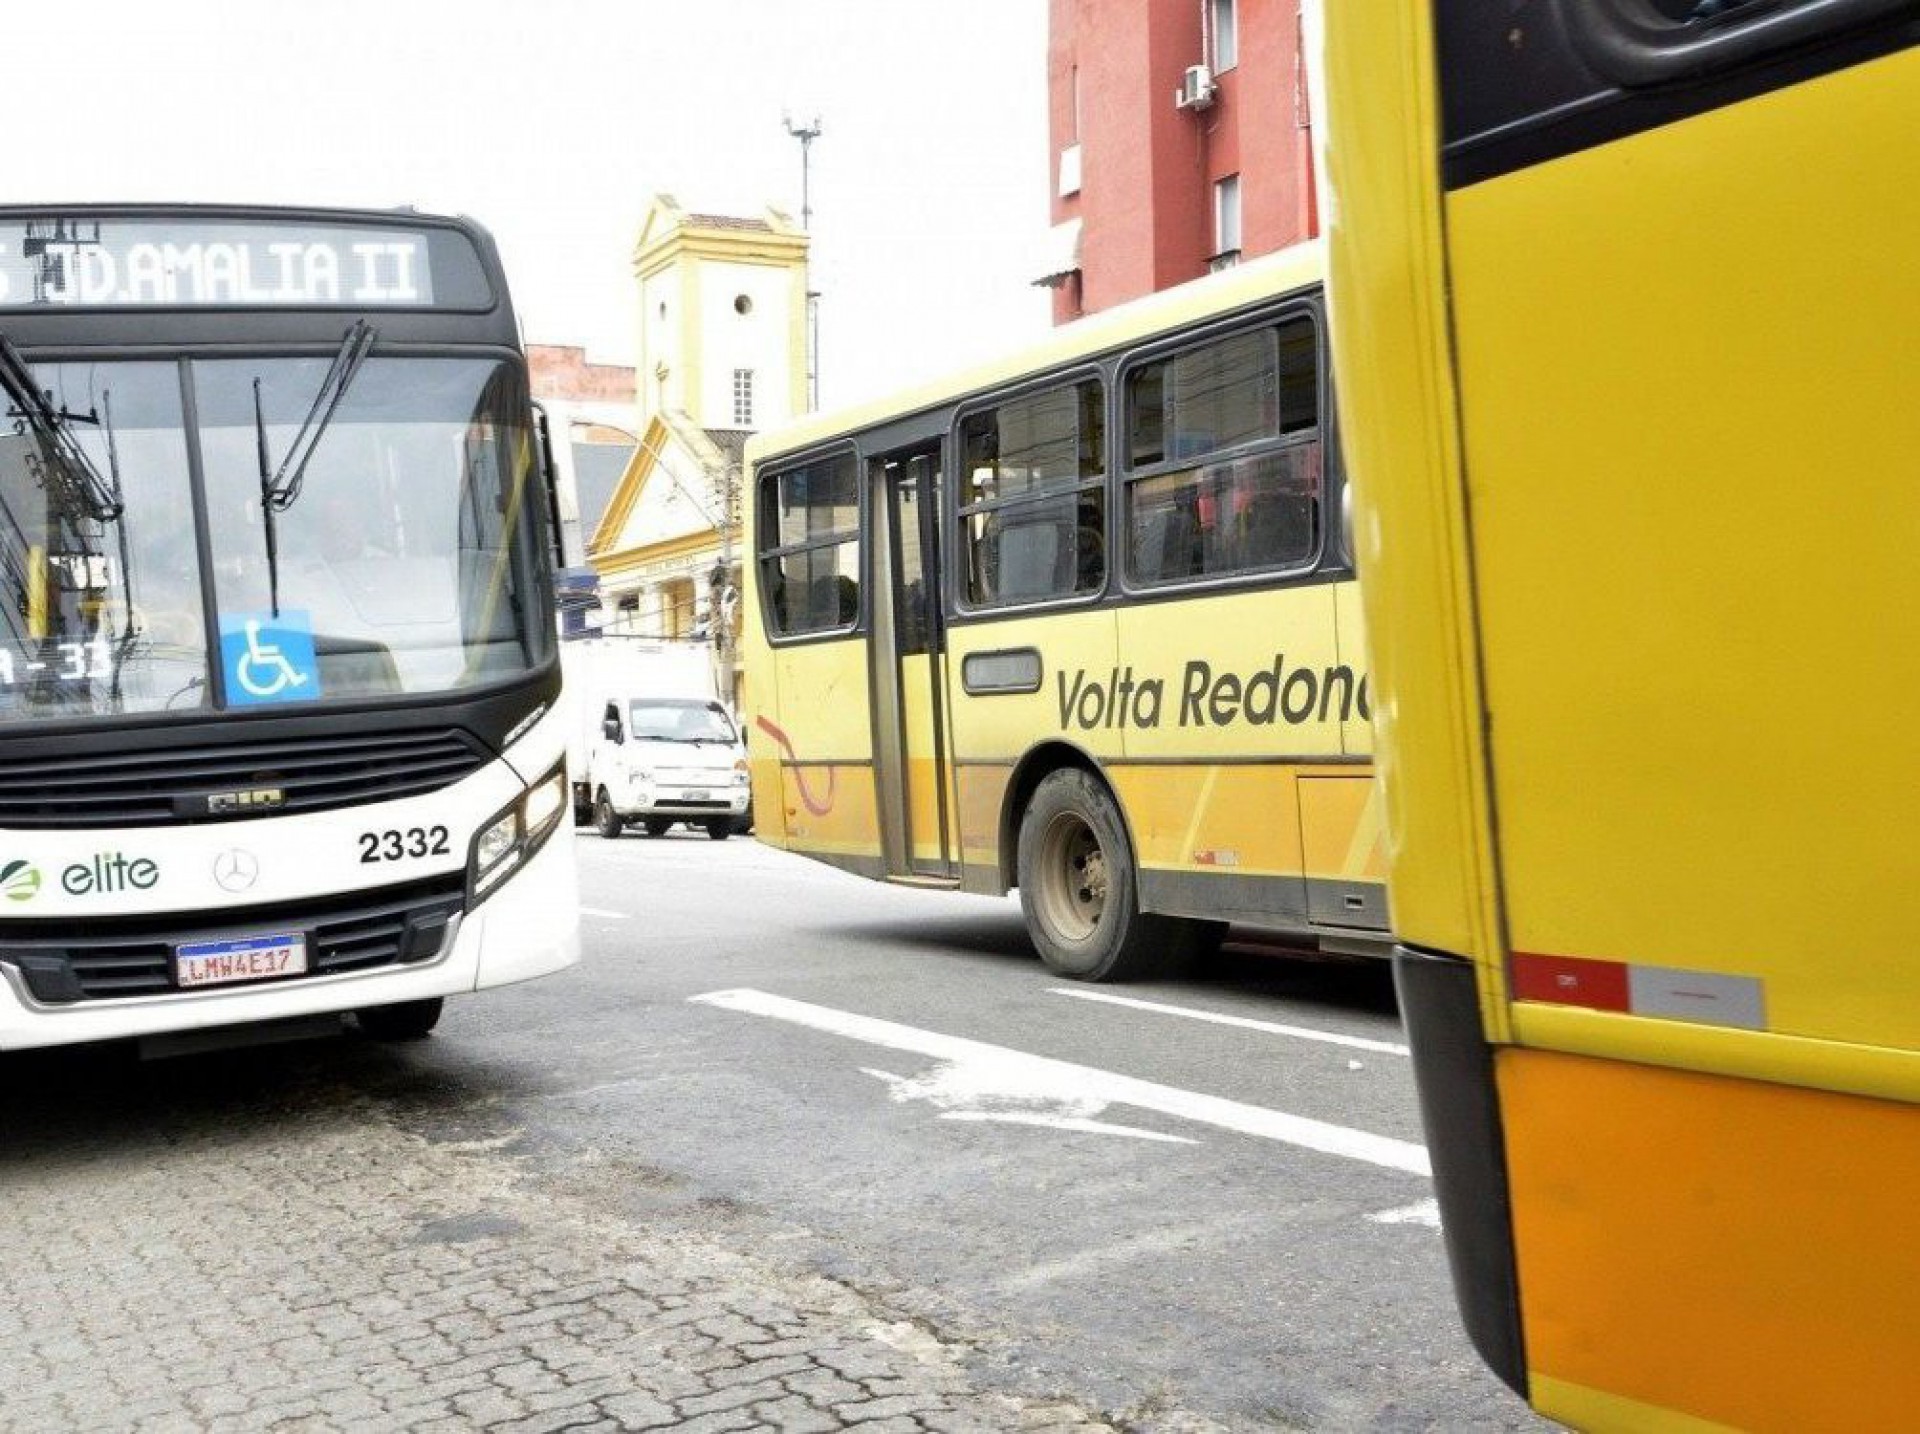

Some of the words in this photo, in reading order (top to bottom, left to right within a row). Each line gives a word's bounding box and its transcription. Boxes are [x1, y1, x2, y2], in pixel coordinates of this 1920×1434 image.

[45, 242, 340, 302] JD.AMALIA
[352, 242, 417, 299] II
[1057, 666, 1164, 730] Volta
[359, 824, 450, 863] 2332
[62, 851, 159, 895] elite
[190, 949, 290, 980] LMW4E17
